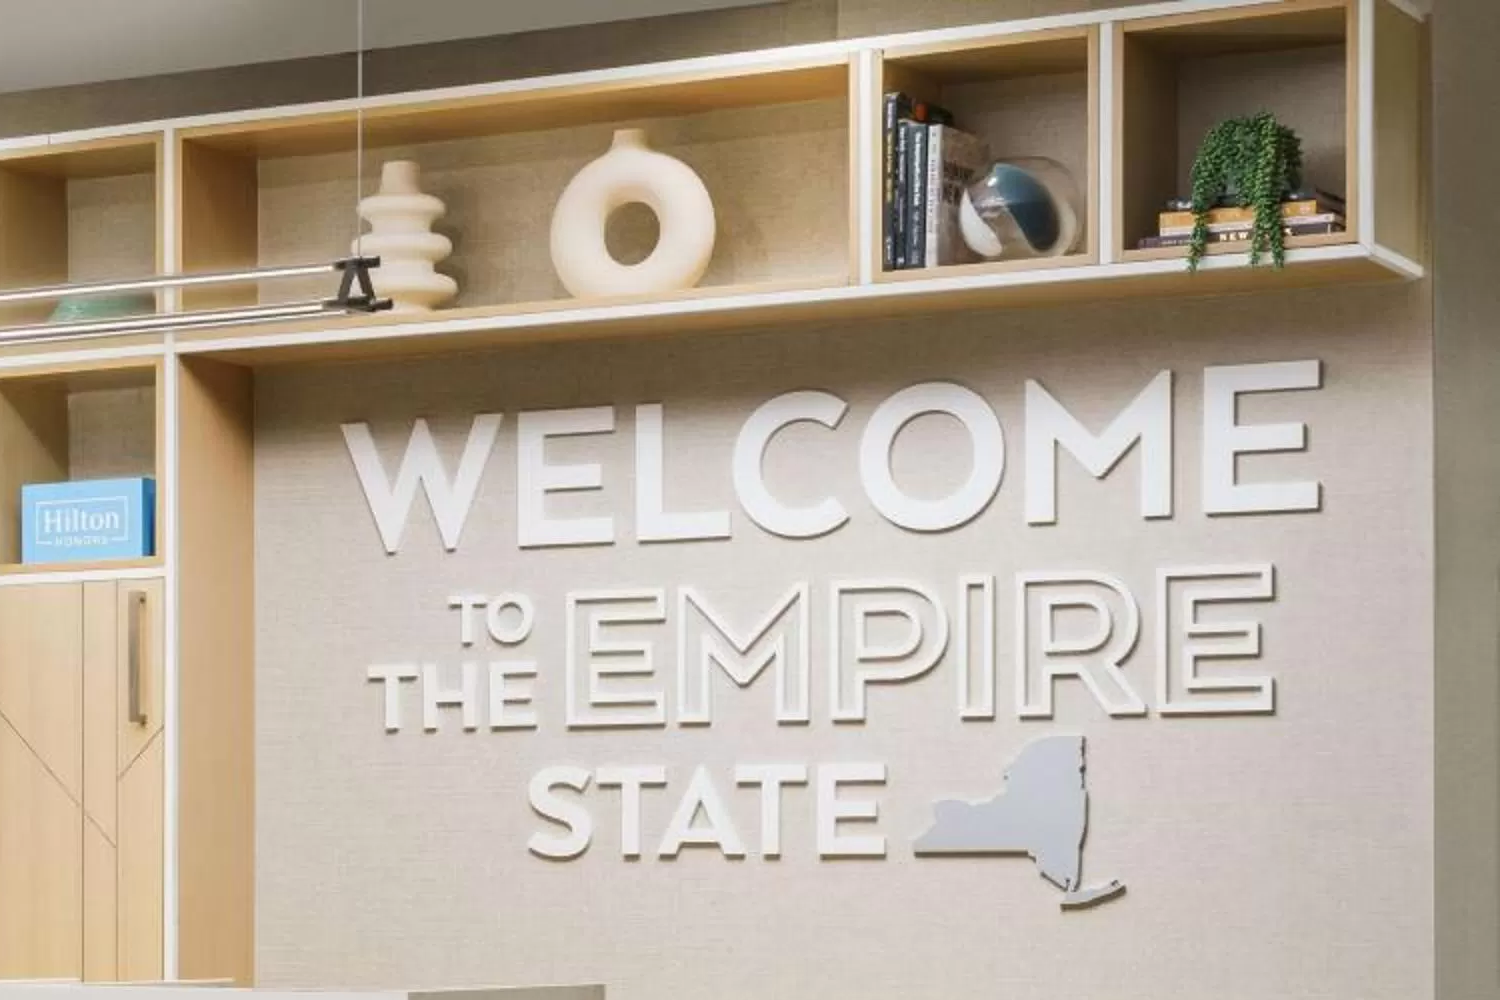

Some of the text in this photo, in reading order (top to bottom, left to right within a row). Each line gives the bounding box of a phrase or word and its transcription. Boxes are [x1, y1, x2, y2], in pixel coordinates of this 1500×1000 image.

[1219, 231, 1249, 242] NEW
[340, 360, 1323, 556] WELCOME
[43, 507, 120, 533] Hilton
[368, 562, 1275, 732] THE EMPIRE
[448, 592, 535, 646] TO
[527, 762, 887, 861] STATE
